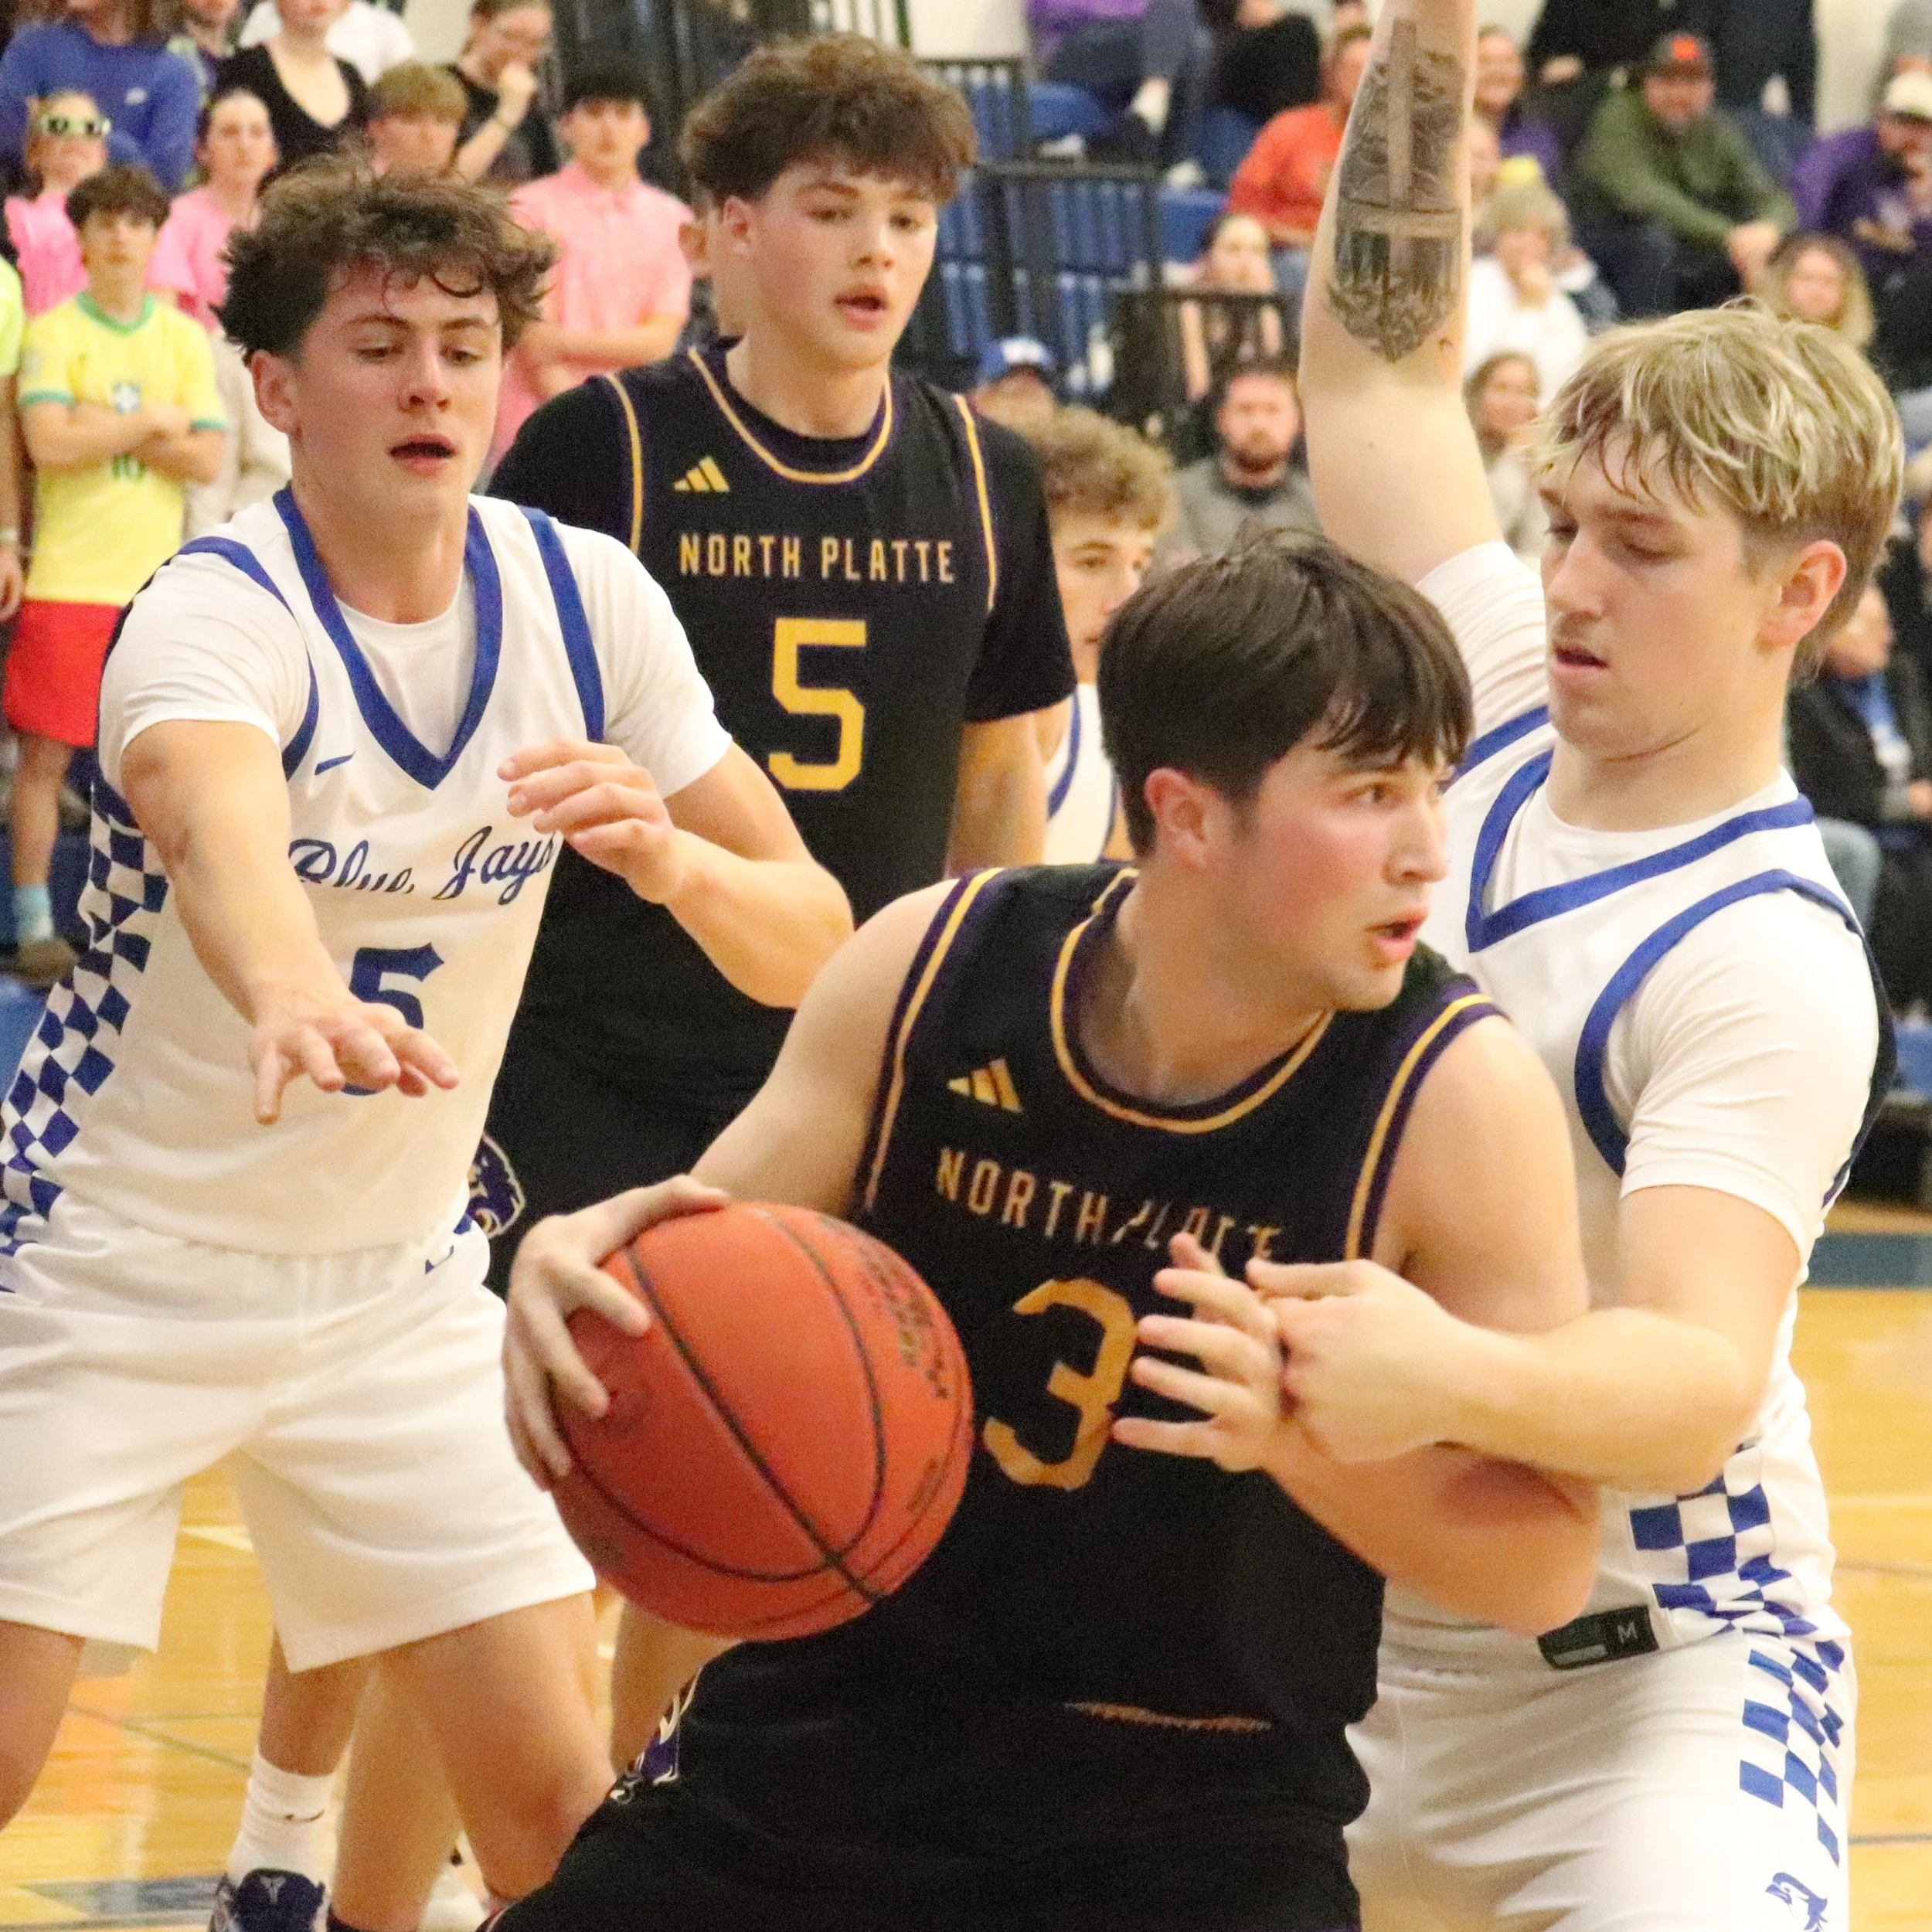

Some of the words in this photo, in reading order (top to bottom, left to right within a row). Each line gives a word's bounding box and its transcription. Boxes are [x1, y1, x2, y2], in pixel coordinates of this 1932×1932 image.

[679, 533, 800, 579] NORTH
[821, 536, 954, 583] PLATTE
[768, 617, 867, 791] 5
[937, 1147, 1107, 1244] NORTH
[983, 1277, 1136, 1491] 3
[1617, 1621, 1638, 1643] M
